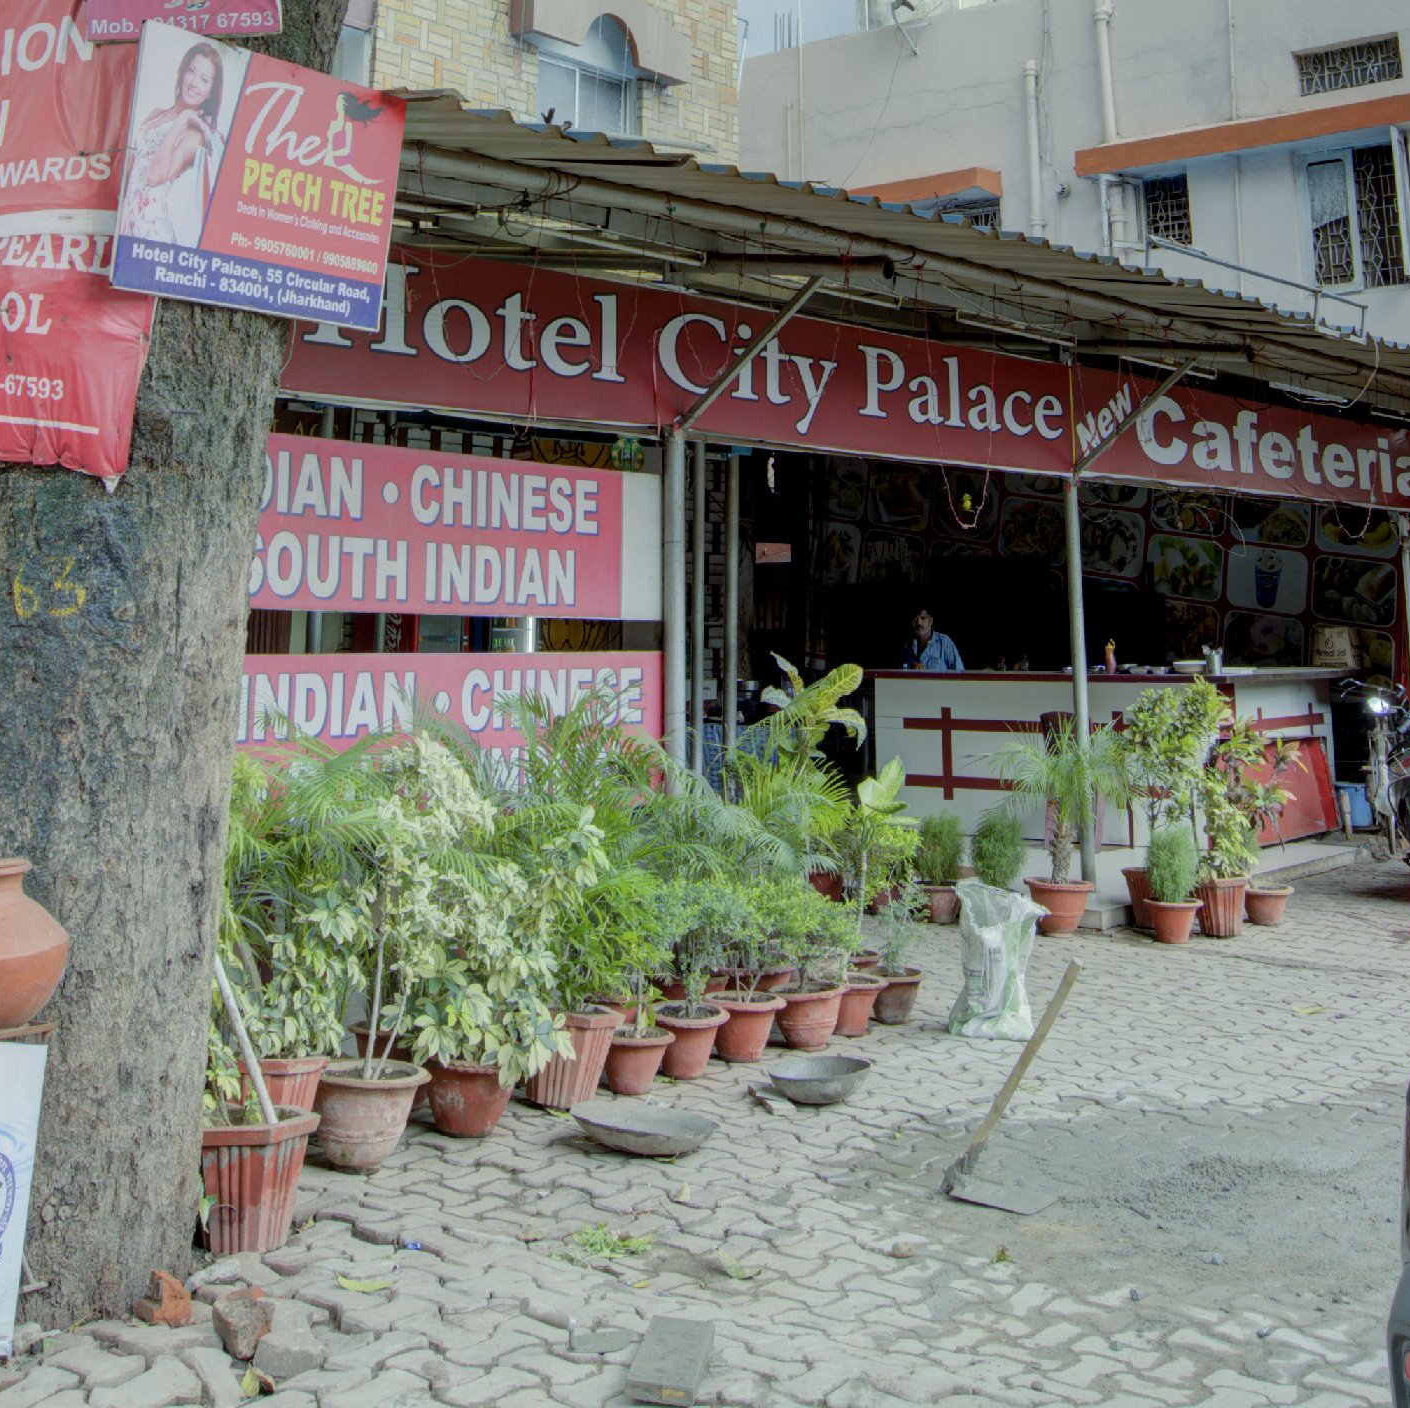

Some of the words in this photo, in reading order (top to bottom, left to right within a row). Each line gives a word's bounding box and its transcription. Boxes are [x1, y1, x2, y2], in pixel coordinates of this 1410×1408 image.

[91, 18, 139, 35] Mob.
[216, 11, 274, 29] 67593
[242, 158, 323, 214] PEACH
[330, 180, 386, 226] TREE
[132, 243, 174, 265] Hotel
[178, 250, 208, 273] City
[211, 258, 262, 285] Palace,
[265, 269, 284, 285] 55
[285, 270, 335, 293] Circular
[337, 283, 370, 304] Road,
[155, 266, 207, 290] Ranchi
[219, 276, 274, 303] 834001,
[277, 288, 351, 317] (Jharkhand)
[302, 261, 627, 384] Hotel
[657, 312, 839, 436] City
[857, 343, 1065, 441] Palace
[1075, 381, 1133, 459] New
[409, 464, 600, 537] CHINESE
[425, 543, 577, 607] INDIAN
[236, 670, 418, 744] INDIAN
[461, 667, 645, 735] CHINESE
